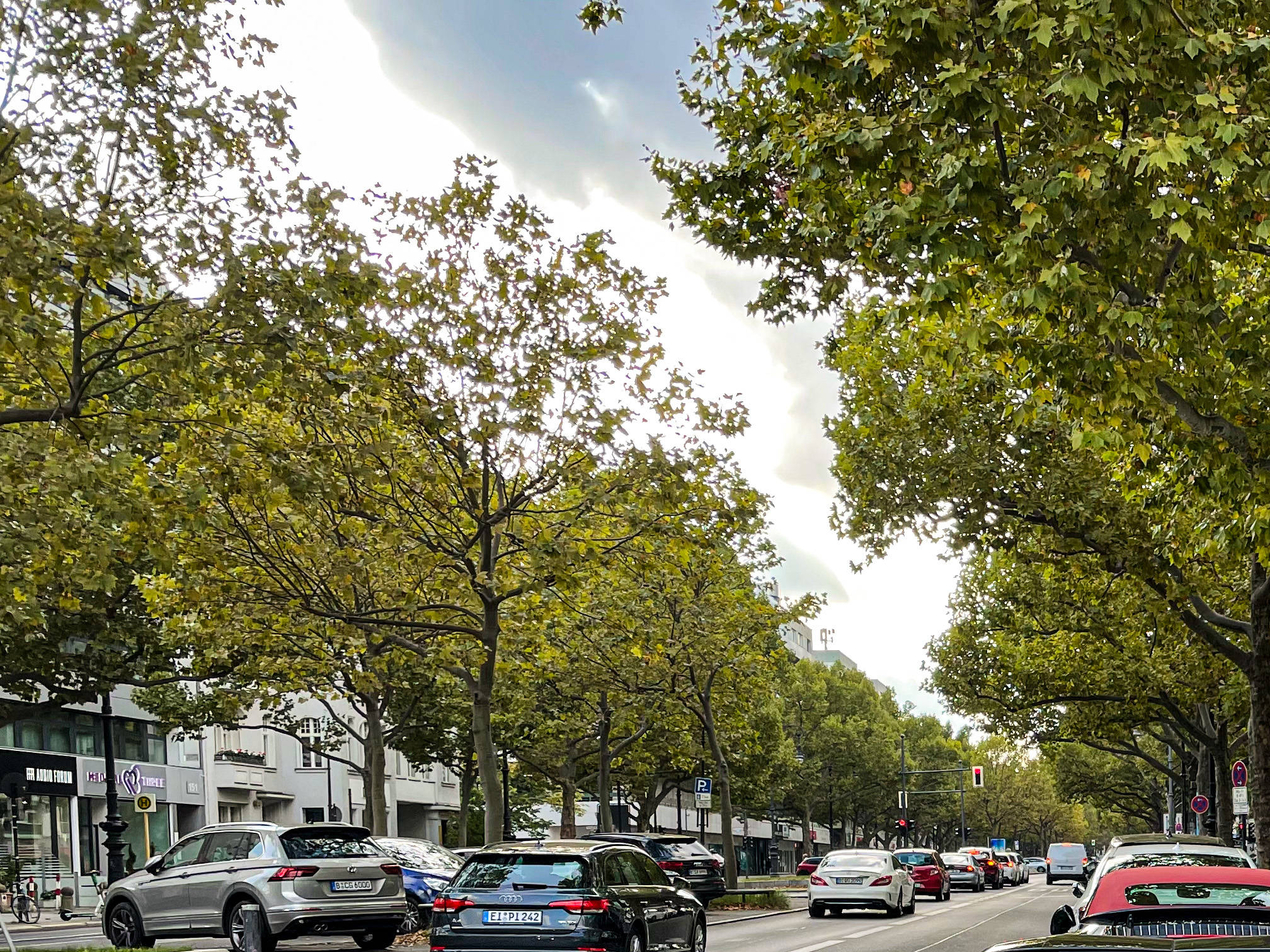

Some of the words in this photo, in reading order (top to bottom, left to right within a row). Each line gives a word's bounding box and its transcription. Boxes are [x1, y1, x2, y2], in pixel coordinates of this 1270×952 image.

[697, 779, 707, 792] P
[490, 912, 501, 921] EI
[521, 912, 540, 921] 242
